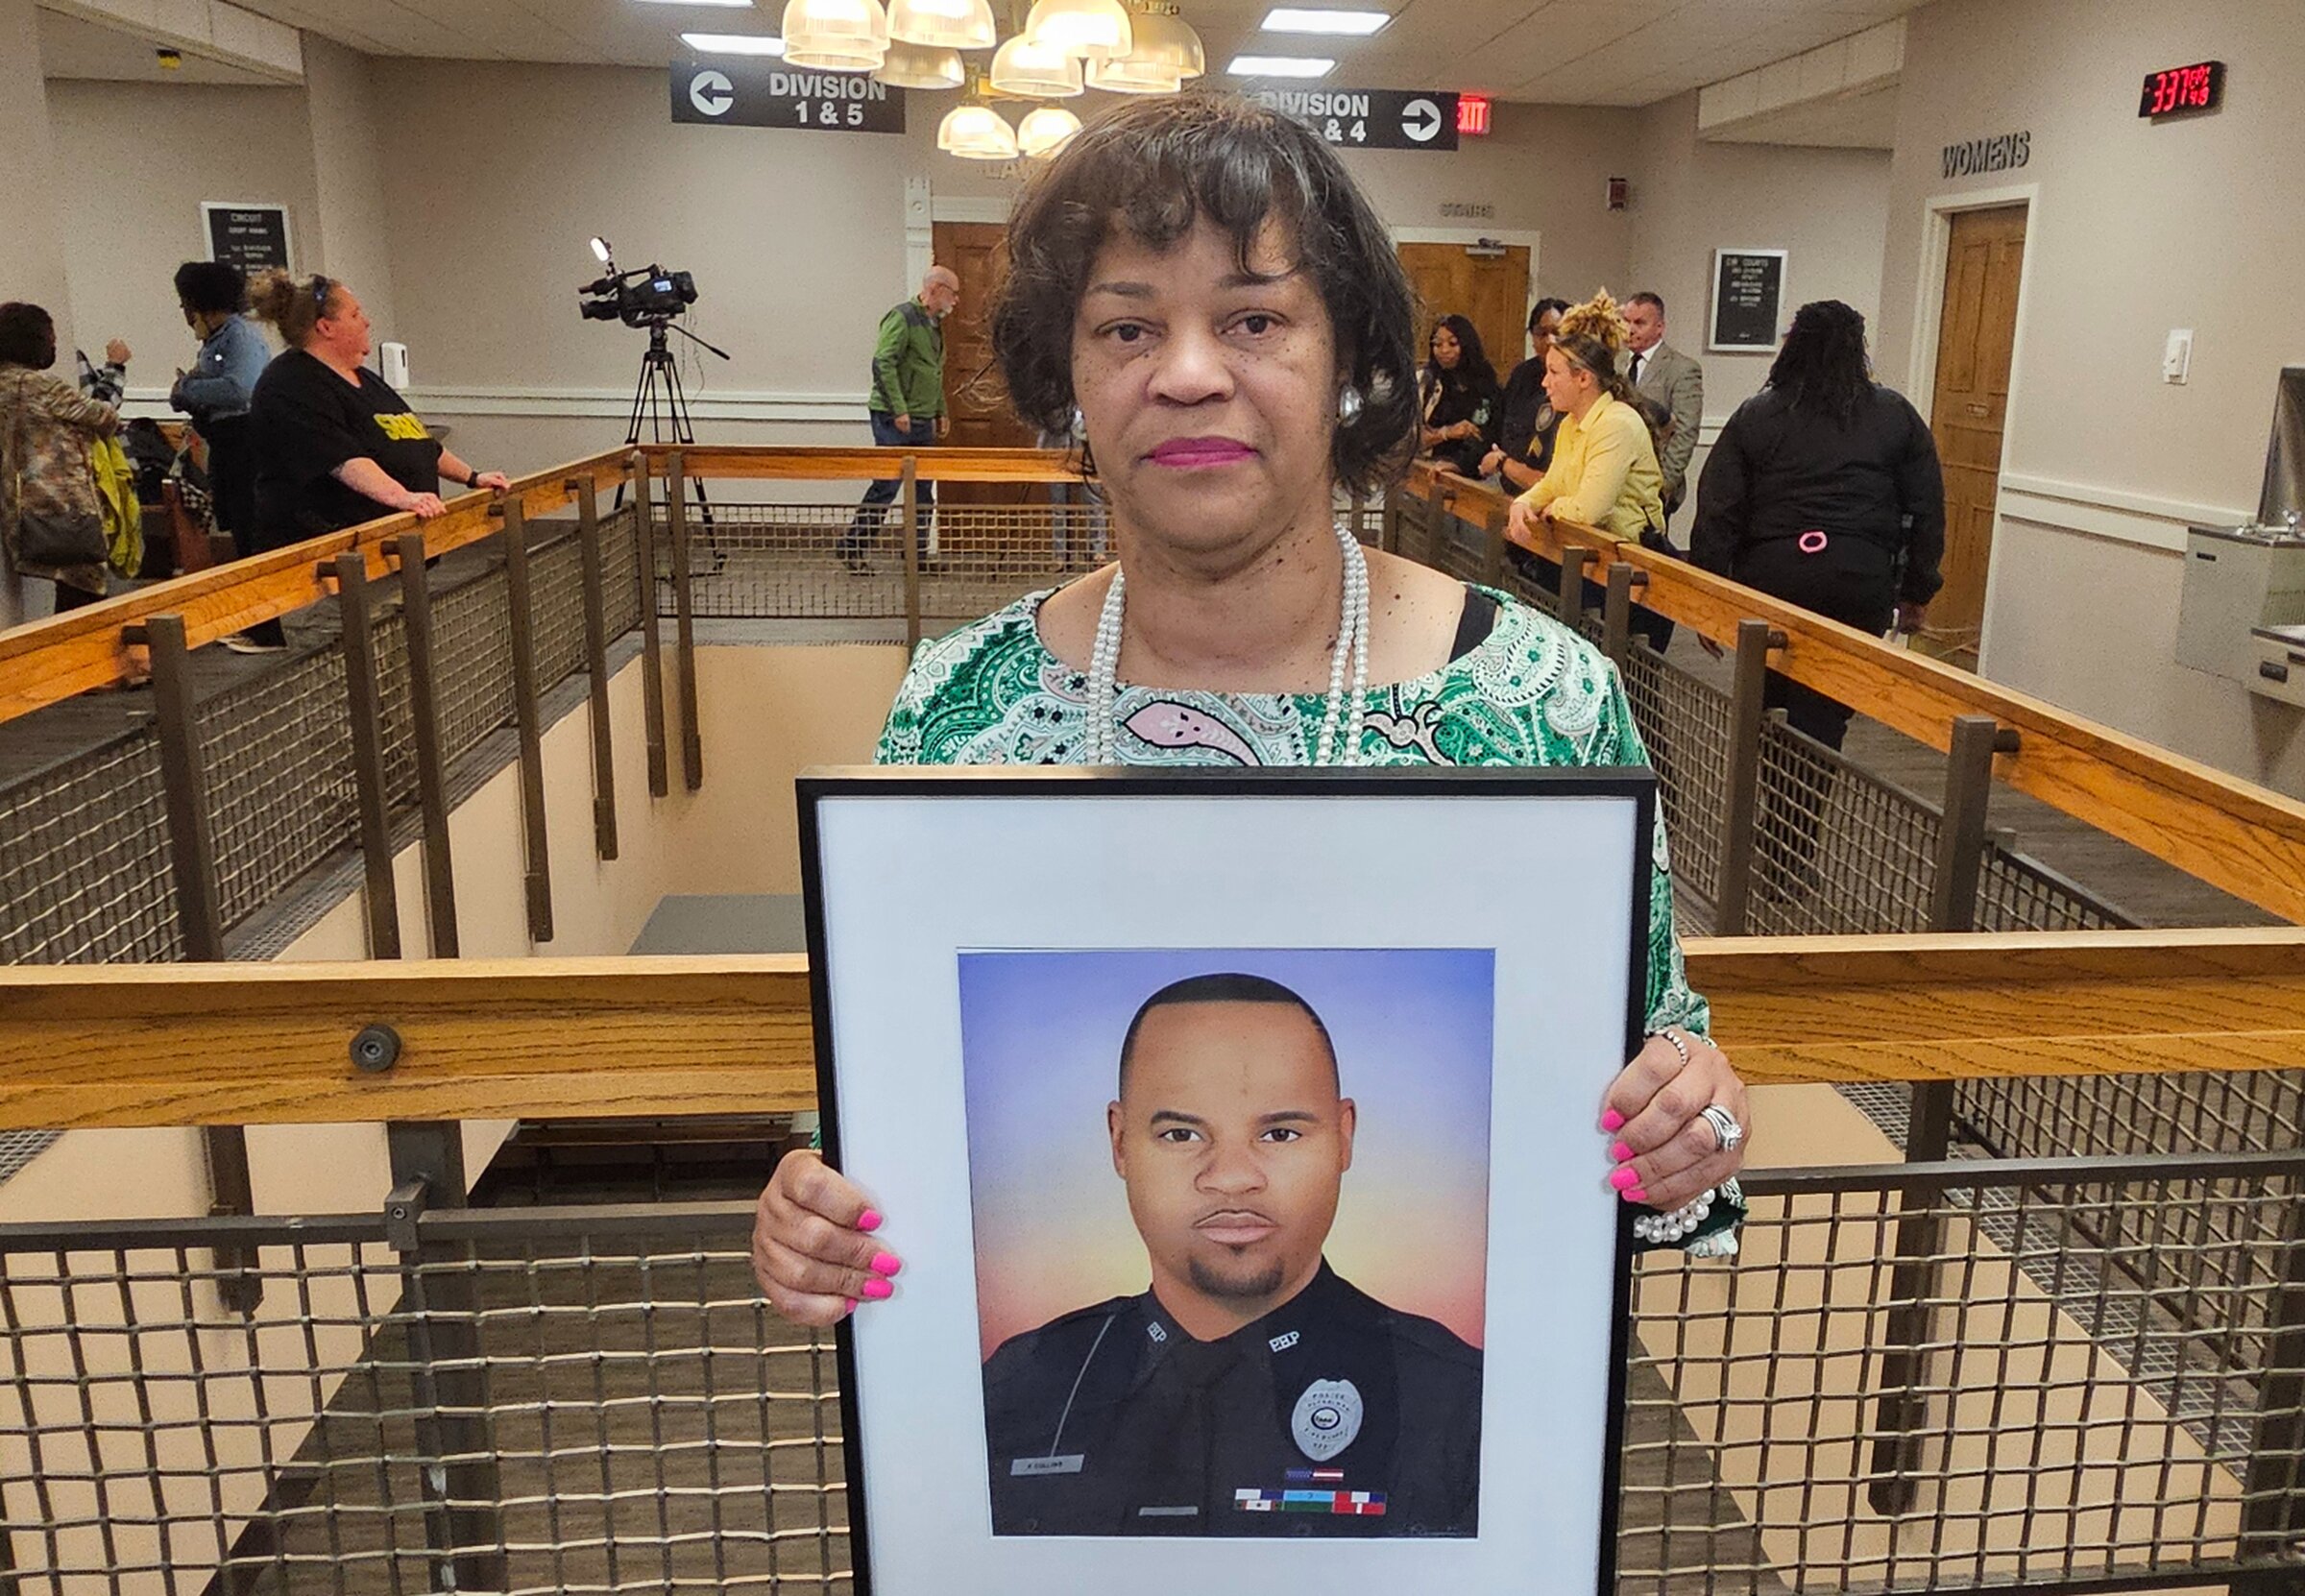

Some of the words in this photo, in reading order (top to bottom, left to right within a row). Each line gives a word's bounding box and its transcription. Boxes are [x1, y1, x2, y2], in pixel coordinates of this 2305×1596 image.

[769, 72, 886, 101] DIVISION
[795, 101, 809, 123] 1
[819, 101, 839, 125] &
[847, 103, 864, 126] 5
[1323, 118, 1344, 142] &
[1349, 119, 1367, 142] 4
[1941, 131, 2031, 180] WOMENS
